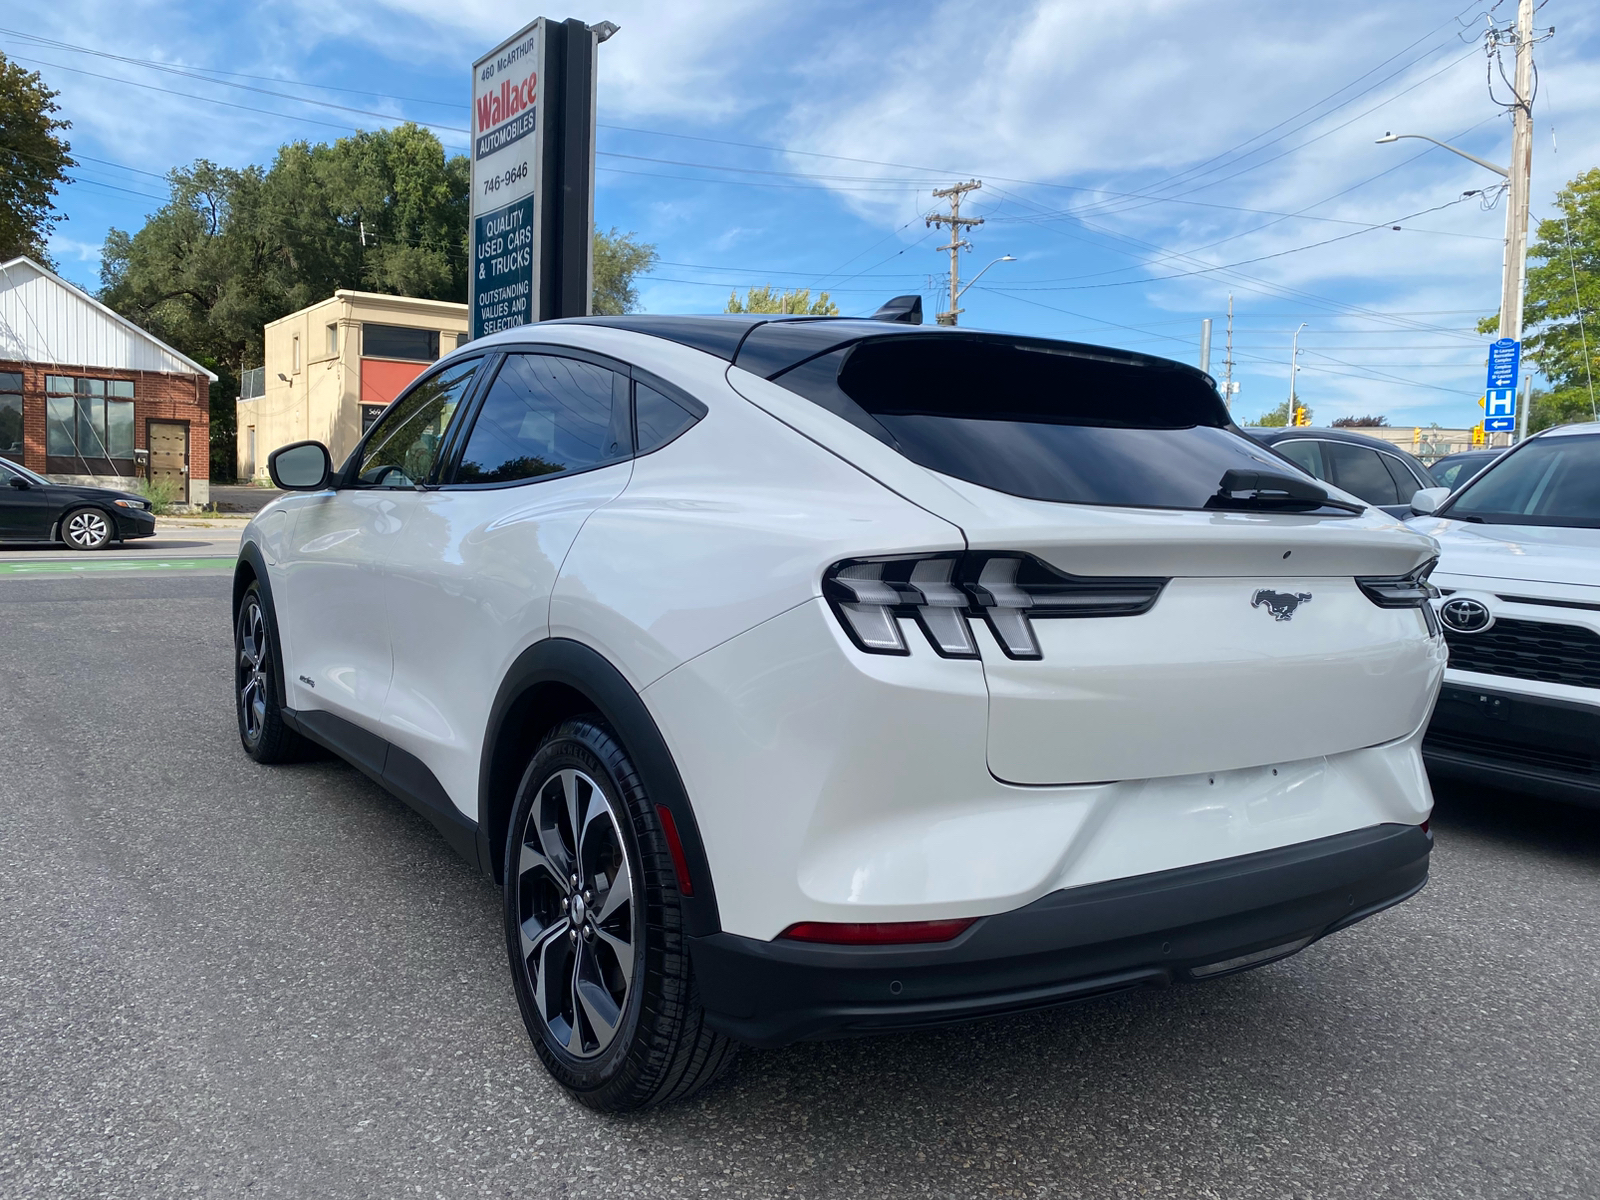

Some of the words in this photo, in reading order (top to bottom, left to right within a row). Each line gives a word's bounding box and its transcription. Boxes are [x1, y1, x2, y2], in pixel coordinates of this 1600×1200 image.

[481, 64, 495, 81] 460
[496, 37, 534, 73] McARTHUR
[477, 71, 537, 133] Wallace
[479, 111, 534, 155] AUTOMOBILES
[484, 161, 528, 195] 746-9646
[486, 208, 524, 238] QUALITY
[478, 237, 504, 260] USED
[507, 225, 531, 250] CARS
[478, 262, 486, 280] &
[490, 247, 530, 276] TRUCKS
[479, 280, 529, 306] OUTSTANDING
[481, 302, 509, 320] VALUES
[511, 297, 527, 313] AND
[483, 313, 524, 335] SELECTION
[1489, 390, 1512, 415] H
